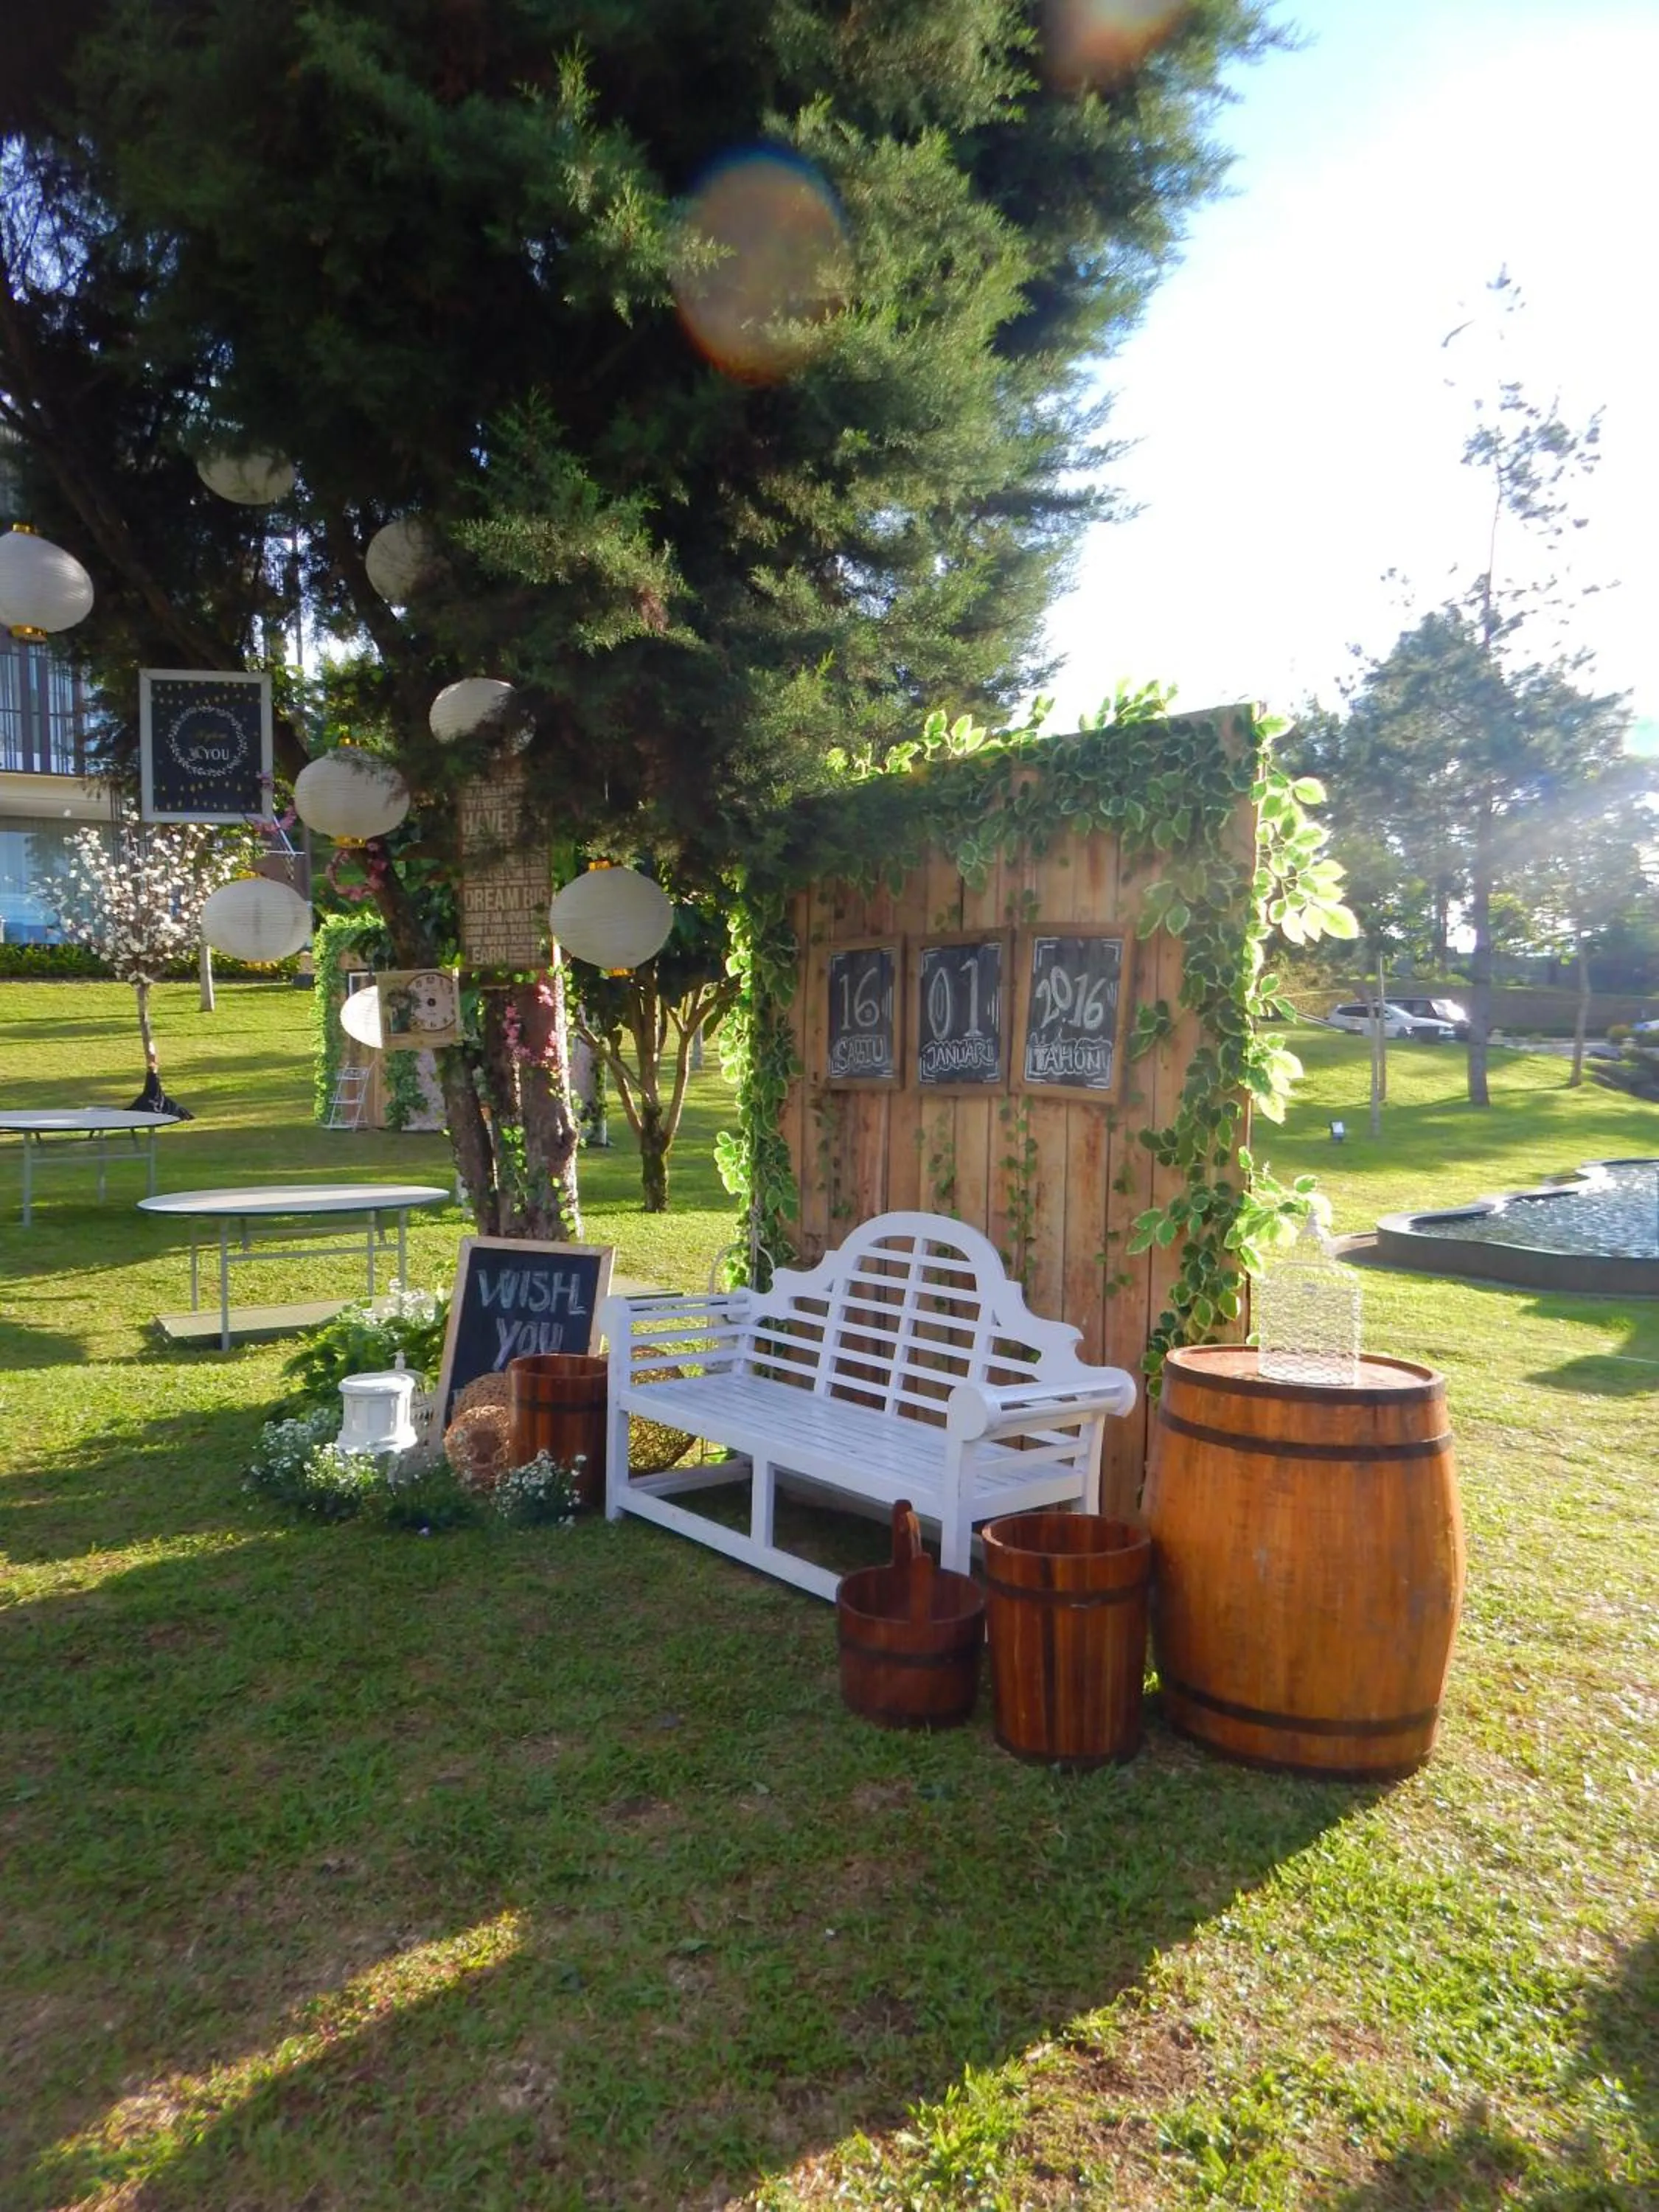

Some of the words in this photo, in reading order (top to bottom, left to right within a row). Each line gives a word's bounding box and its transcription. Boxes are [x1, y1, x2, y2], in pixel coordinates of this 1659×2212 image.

[204, 748, 229, 760] YOU
[464, 887, 519, 911] DREAM
[839, 967, 880, 1030] 16
[928, 958, 983, 1040] 01
[476, 1269, 587, 1315] WISH
